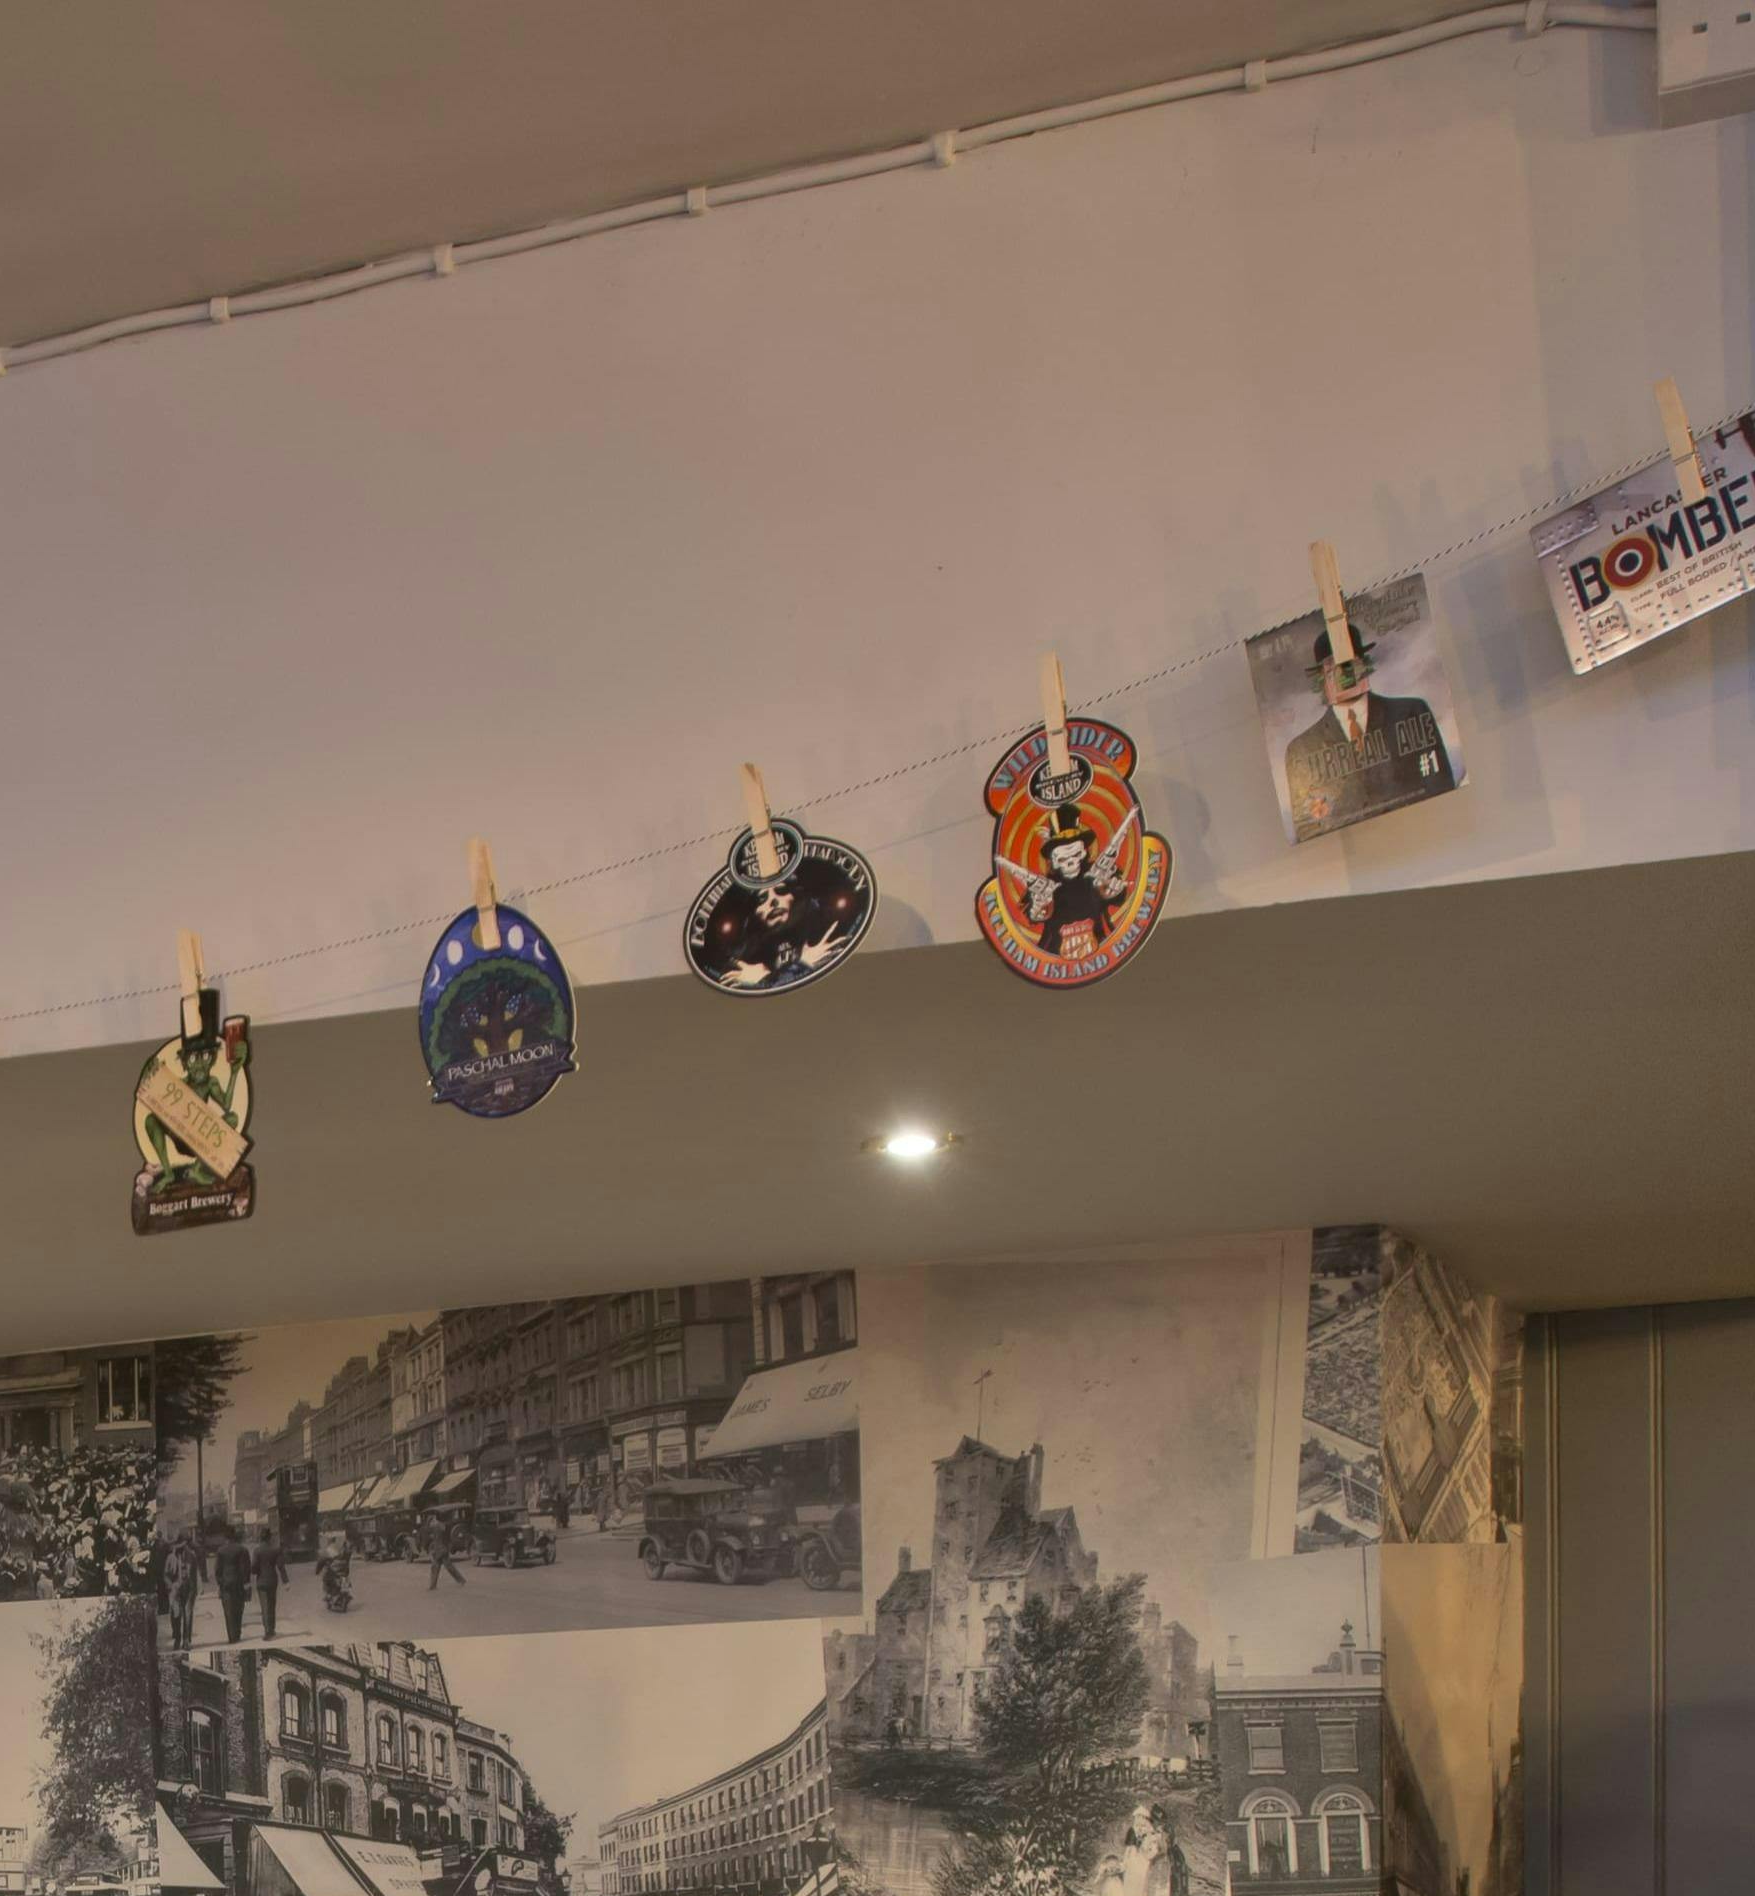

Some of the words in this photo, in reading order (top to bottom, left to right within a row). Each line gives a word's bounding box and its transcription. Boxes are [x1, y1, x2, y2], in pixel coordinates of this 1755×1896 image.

[1655, 572, 1682, 590] BEST
[1683, 563, 1701, 577] OF
[1701, 541, 1743, 567] BRITISH
[1659, 582, 1686, 600] FULL
[1687, 563, 1728, 586] BODIED
[1395, 711, 1437, 757] ALE
[1419, 750, 1440, 779] #1
[1041, 778, 1083, 801] ISLAND
[1043, 953, 1110, 979] ISLAND
[447, 1055, 509, 1081] PASCHAL
[509, 1043, 554, 1065] MOON
[161, 1082, 184, 1107] 99
[184, 1101, 228, 1149] STEPS
[149, 1199, 188, 1216] Boggart
[191, 1193, 234, 1209] Brewery
